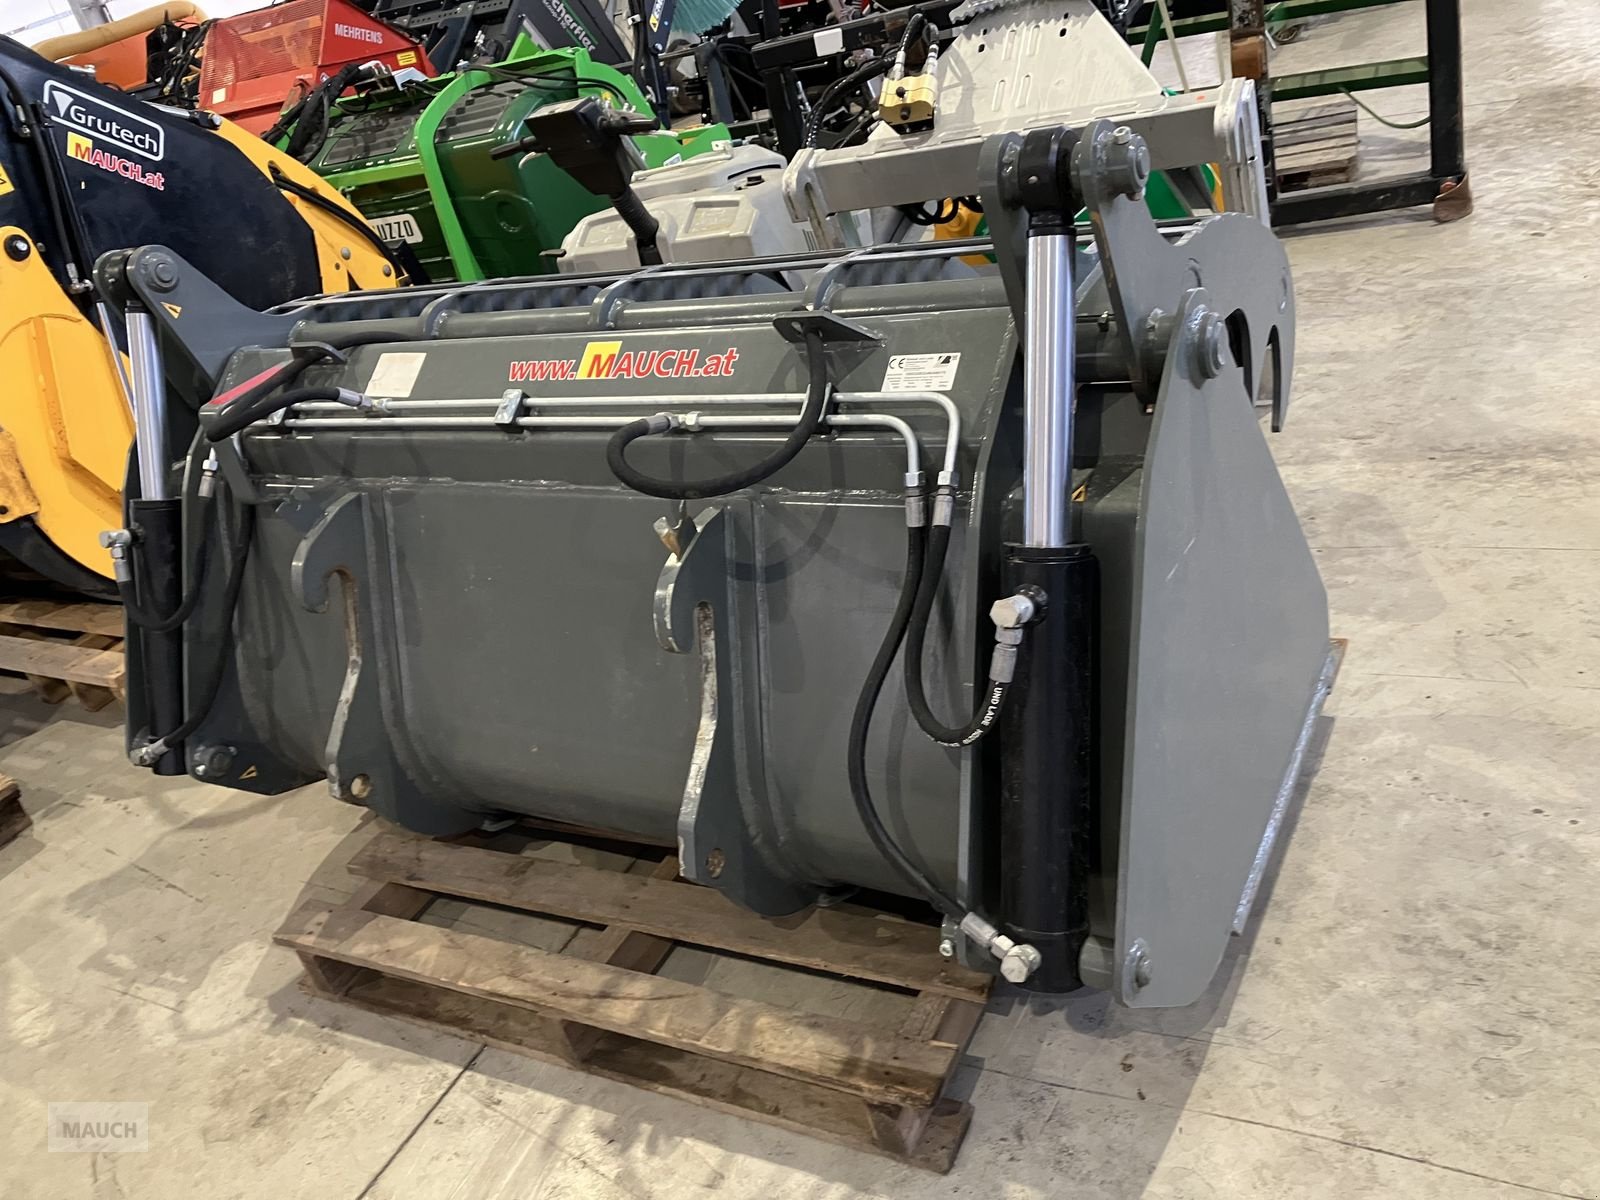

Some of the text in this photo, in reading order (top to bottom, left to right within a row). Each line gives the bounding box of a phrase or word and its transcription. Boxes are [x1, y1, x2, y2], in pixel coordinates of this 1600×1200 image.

[335, 23, 383, 44] MEHRTENS
[70, 105, 158, 153] Grutech
[75, 142, 165, 190] MAUCH.at
[372, 220, 414, 240] UZZO
[509, 347, 739, 381] www.MAUCH.at
[981, 687, 1003, 726] UND LADE
